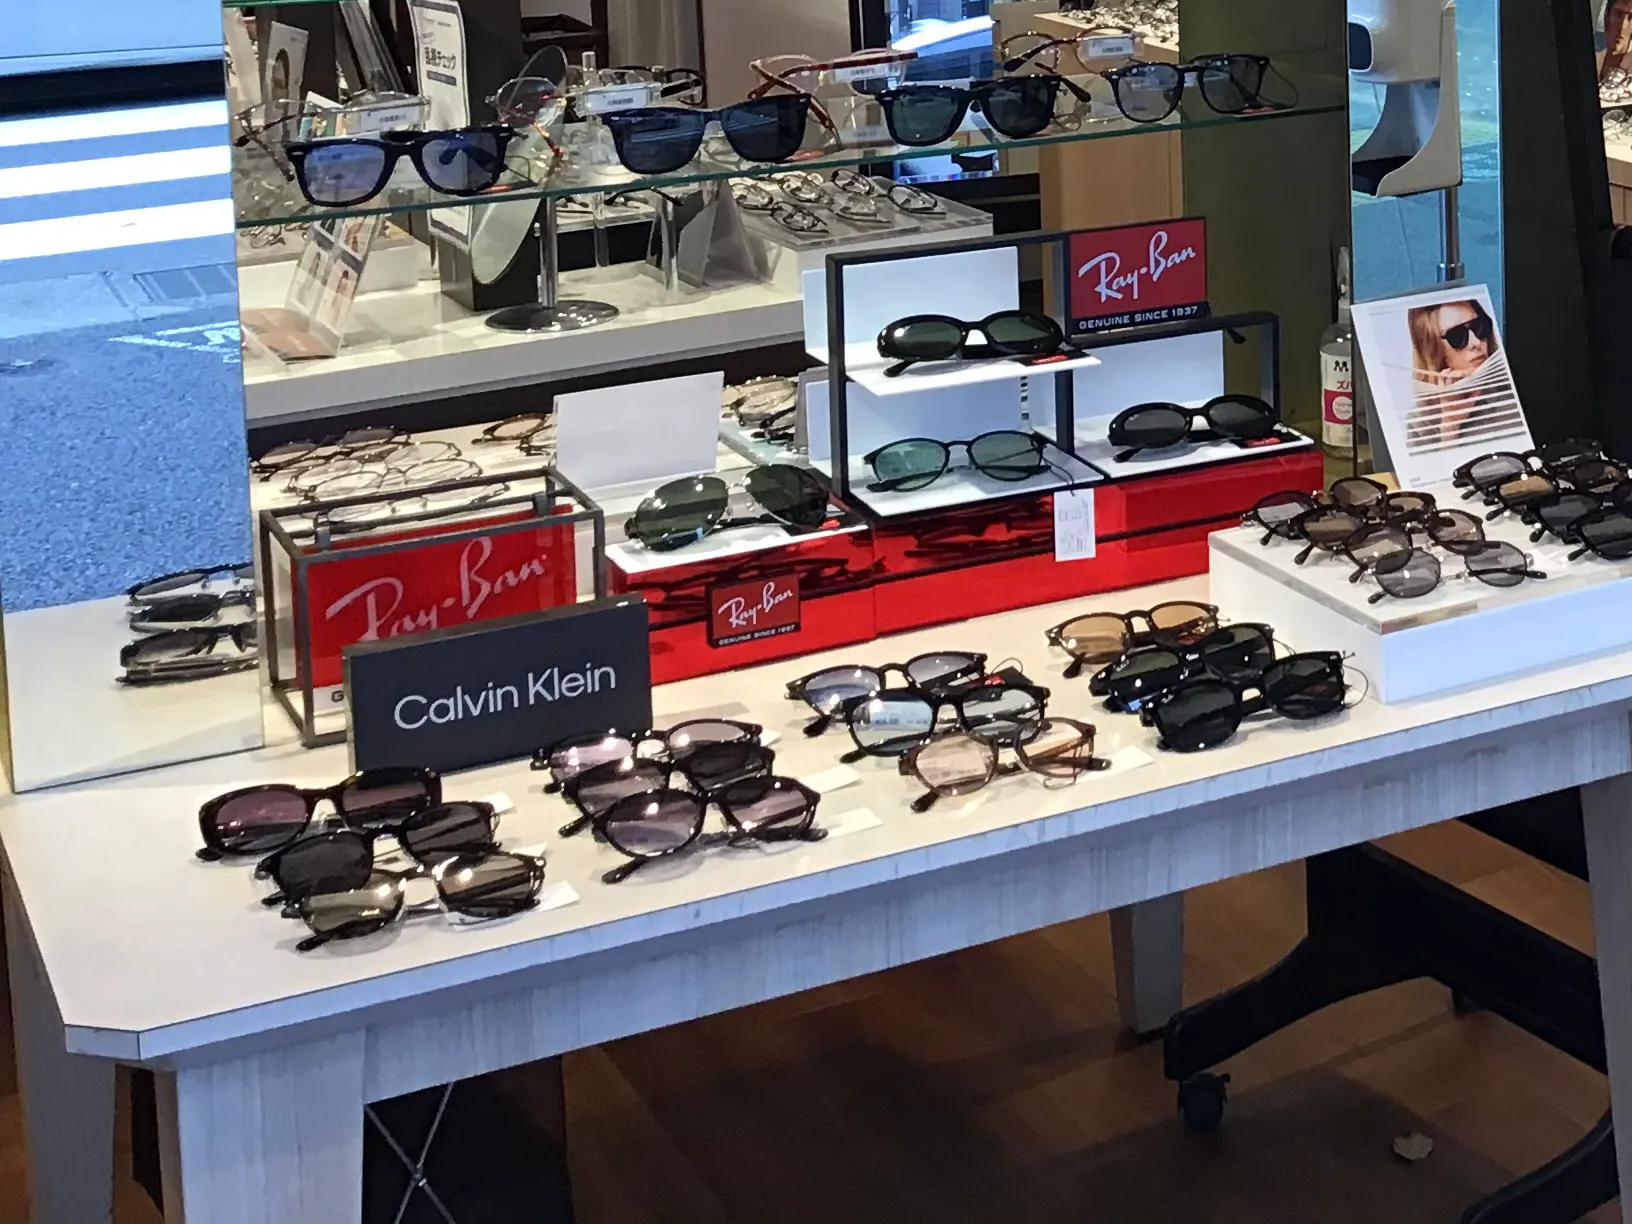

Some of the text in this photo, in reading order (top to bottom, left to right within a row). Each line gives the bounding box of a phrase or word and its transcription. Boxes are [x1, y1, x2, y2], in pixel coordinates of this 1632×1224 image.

[1078, 305, 1198, 330] GENUINE SINCE 1937
[392, 662, 617, 731] Calvin Klein
